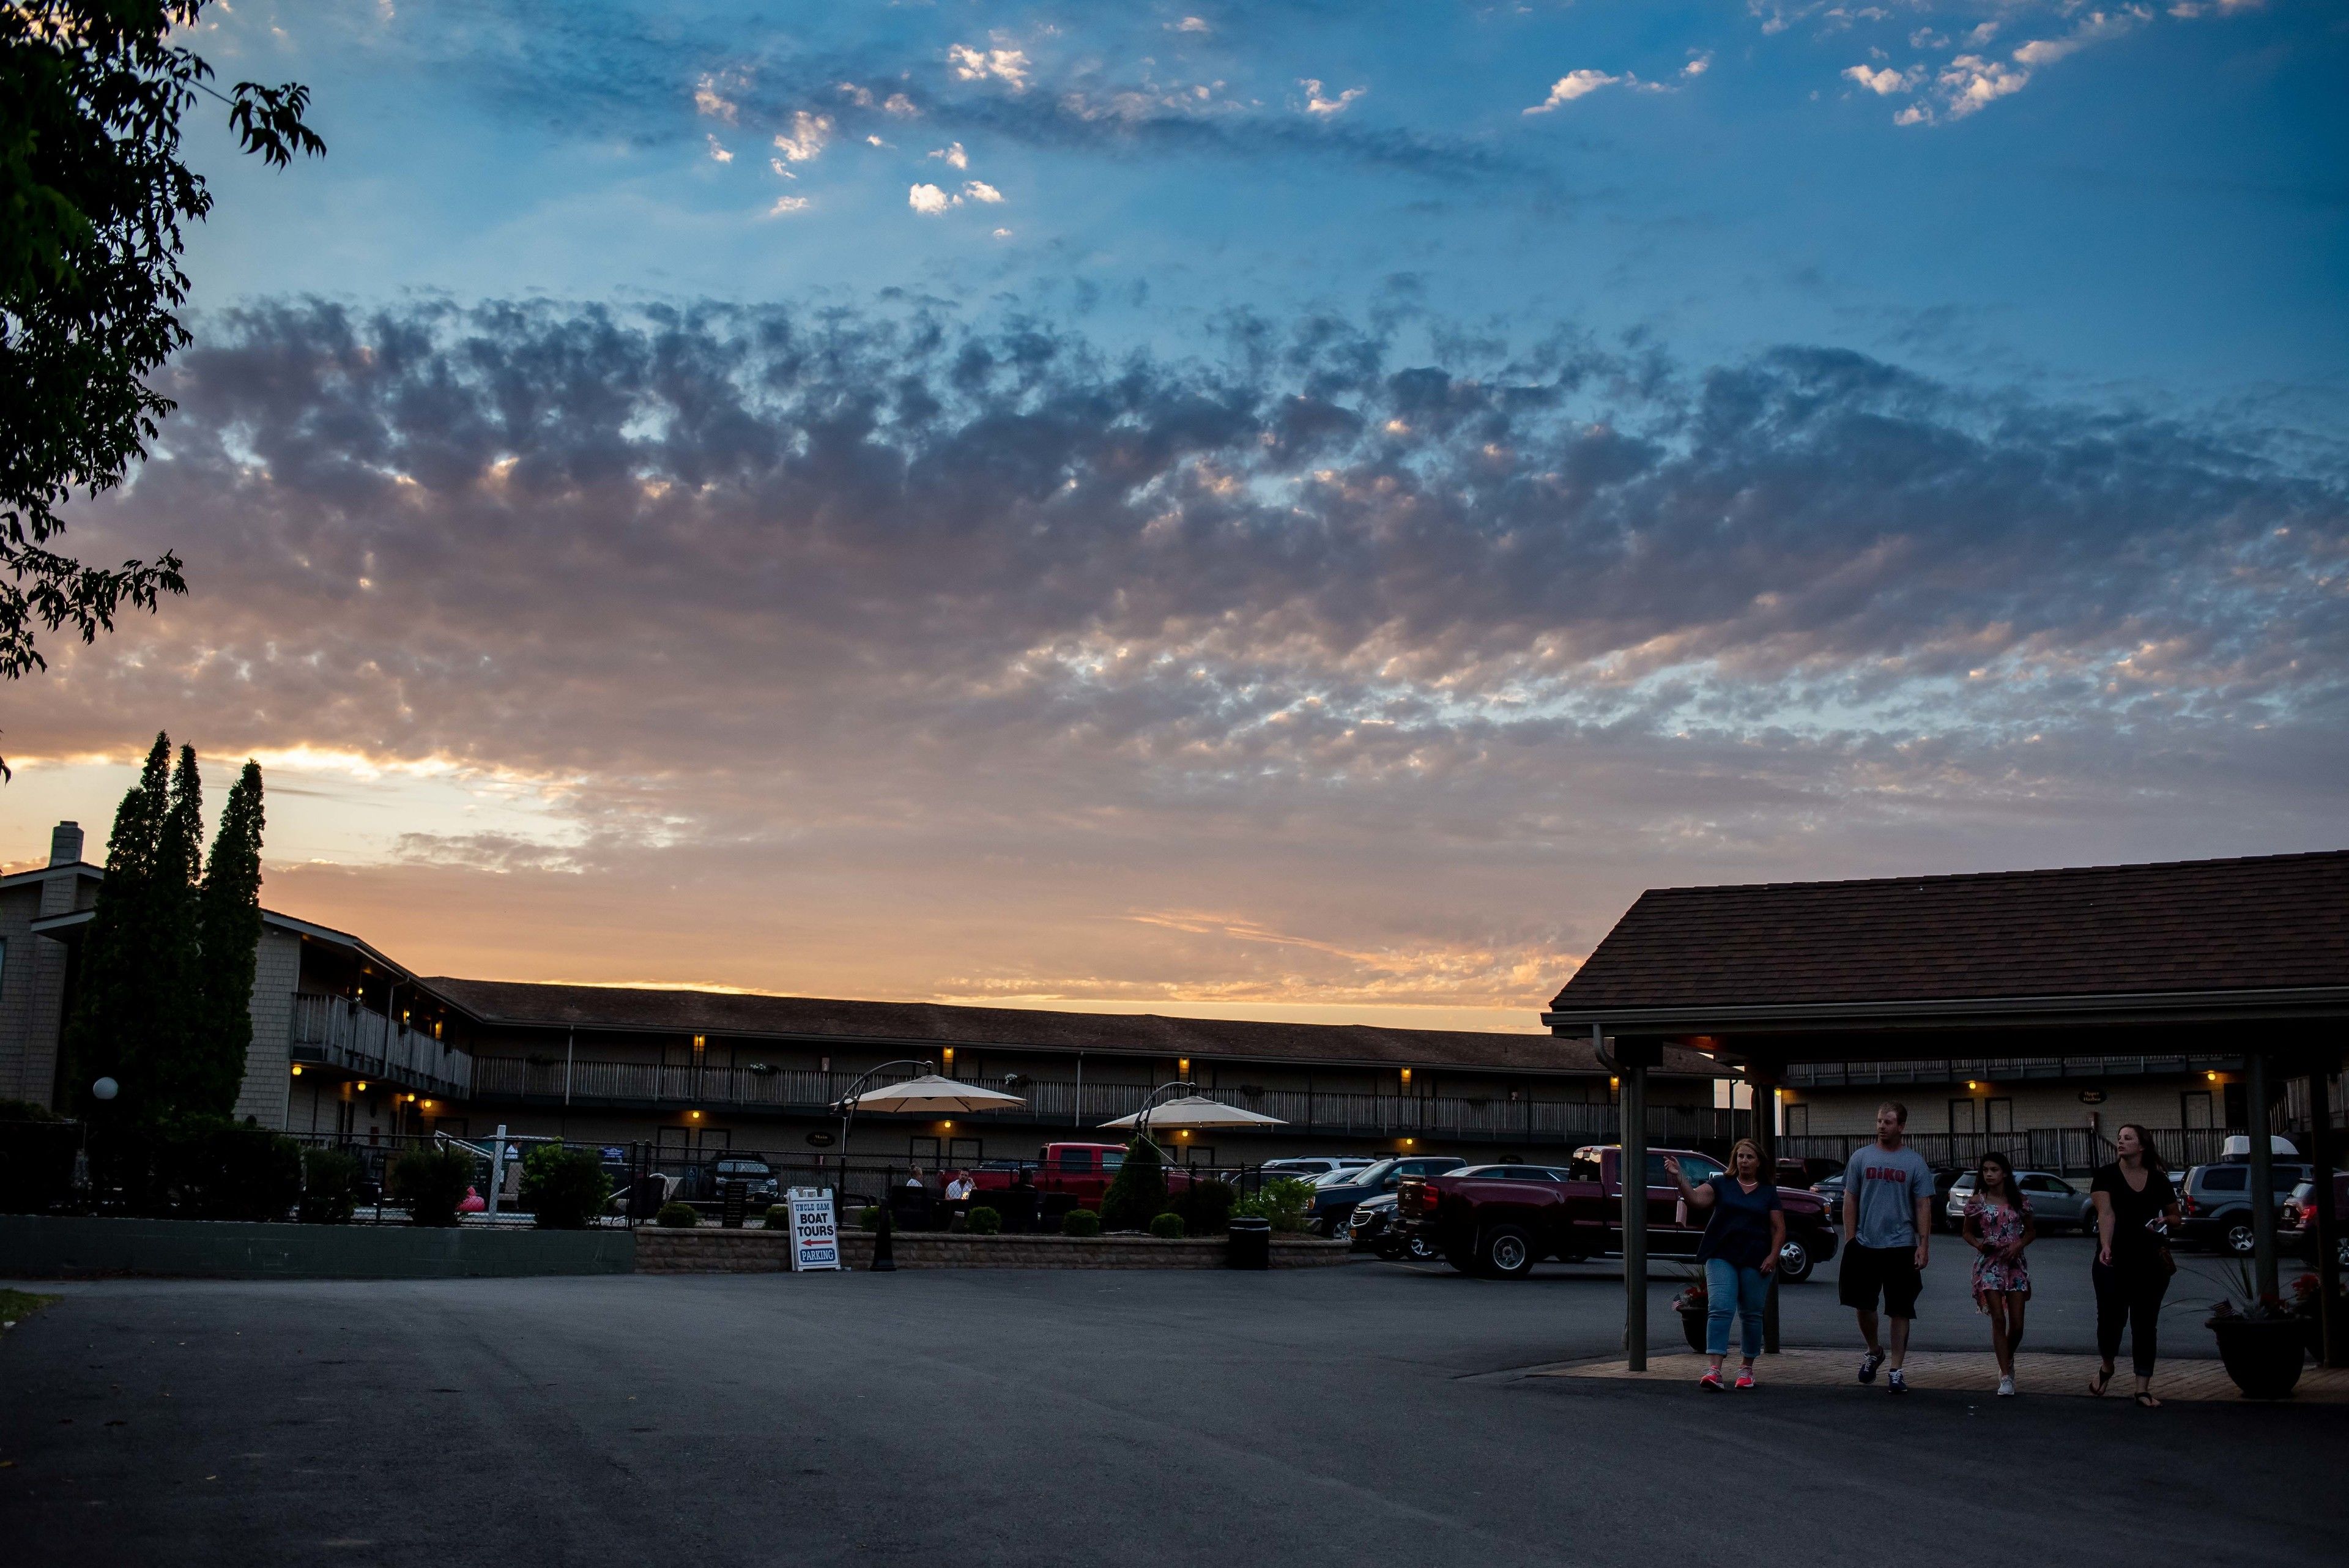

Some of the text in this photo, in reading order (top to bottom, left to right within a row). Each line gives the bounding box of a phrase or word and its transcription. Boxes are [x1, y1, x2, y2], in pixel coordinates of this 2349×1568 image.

[800, 1213, 828, 1224] BOAT
[797, 1225, 834, 1237] TOURS
[801, 1249, 834, 1261] PARKING
